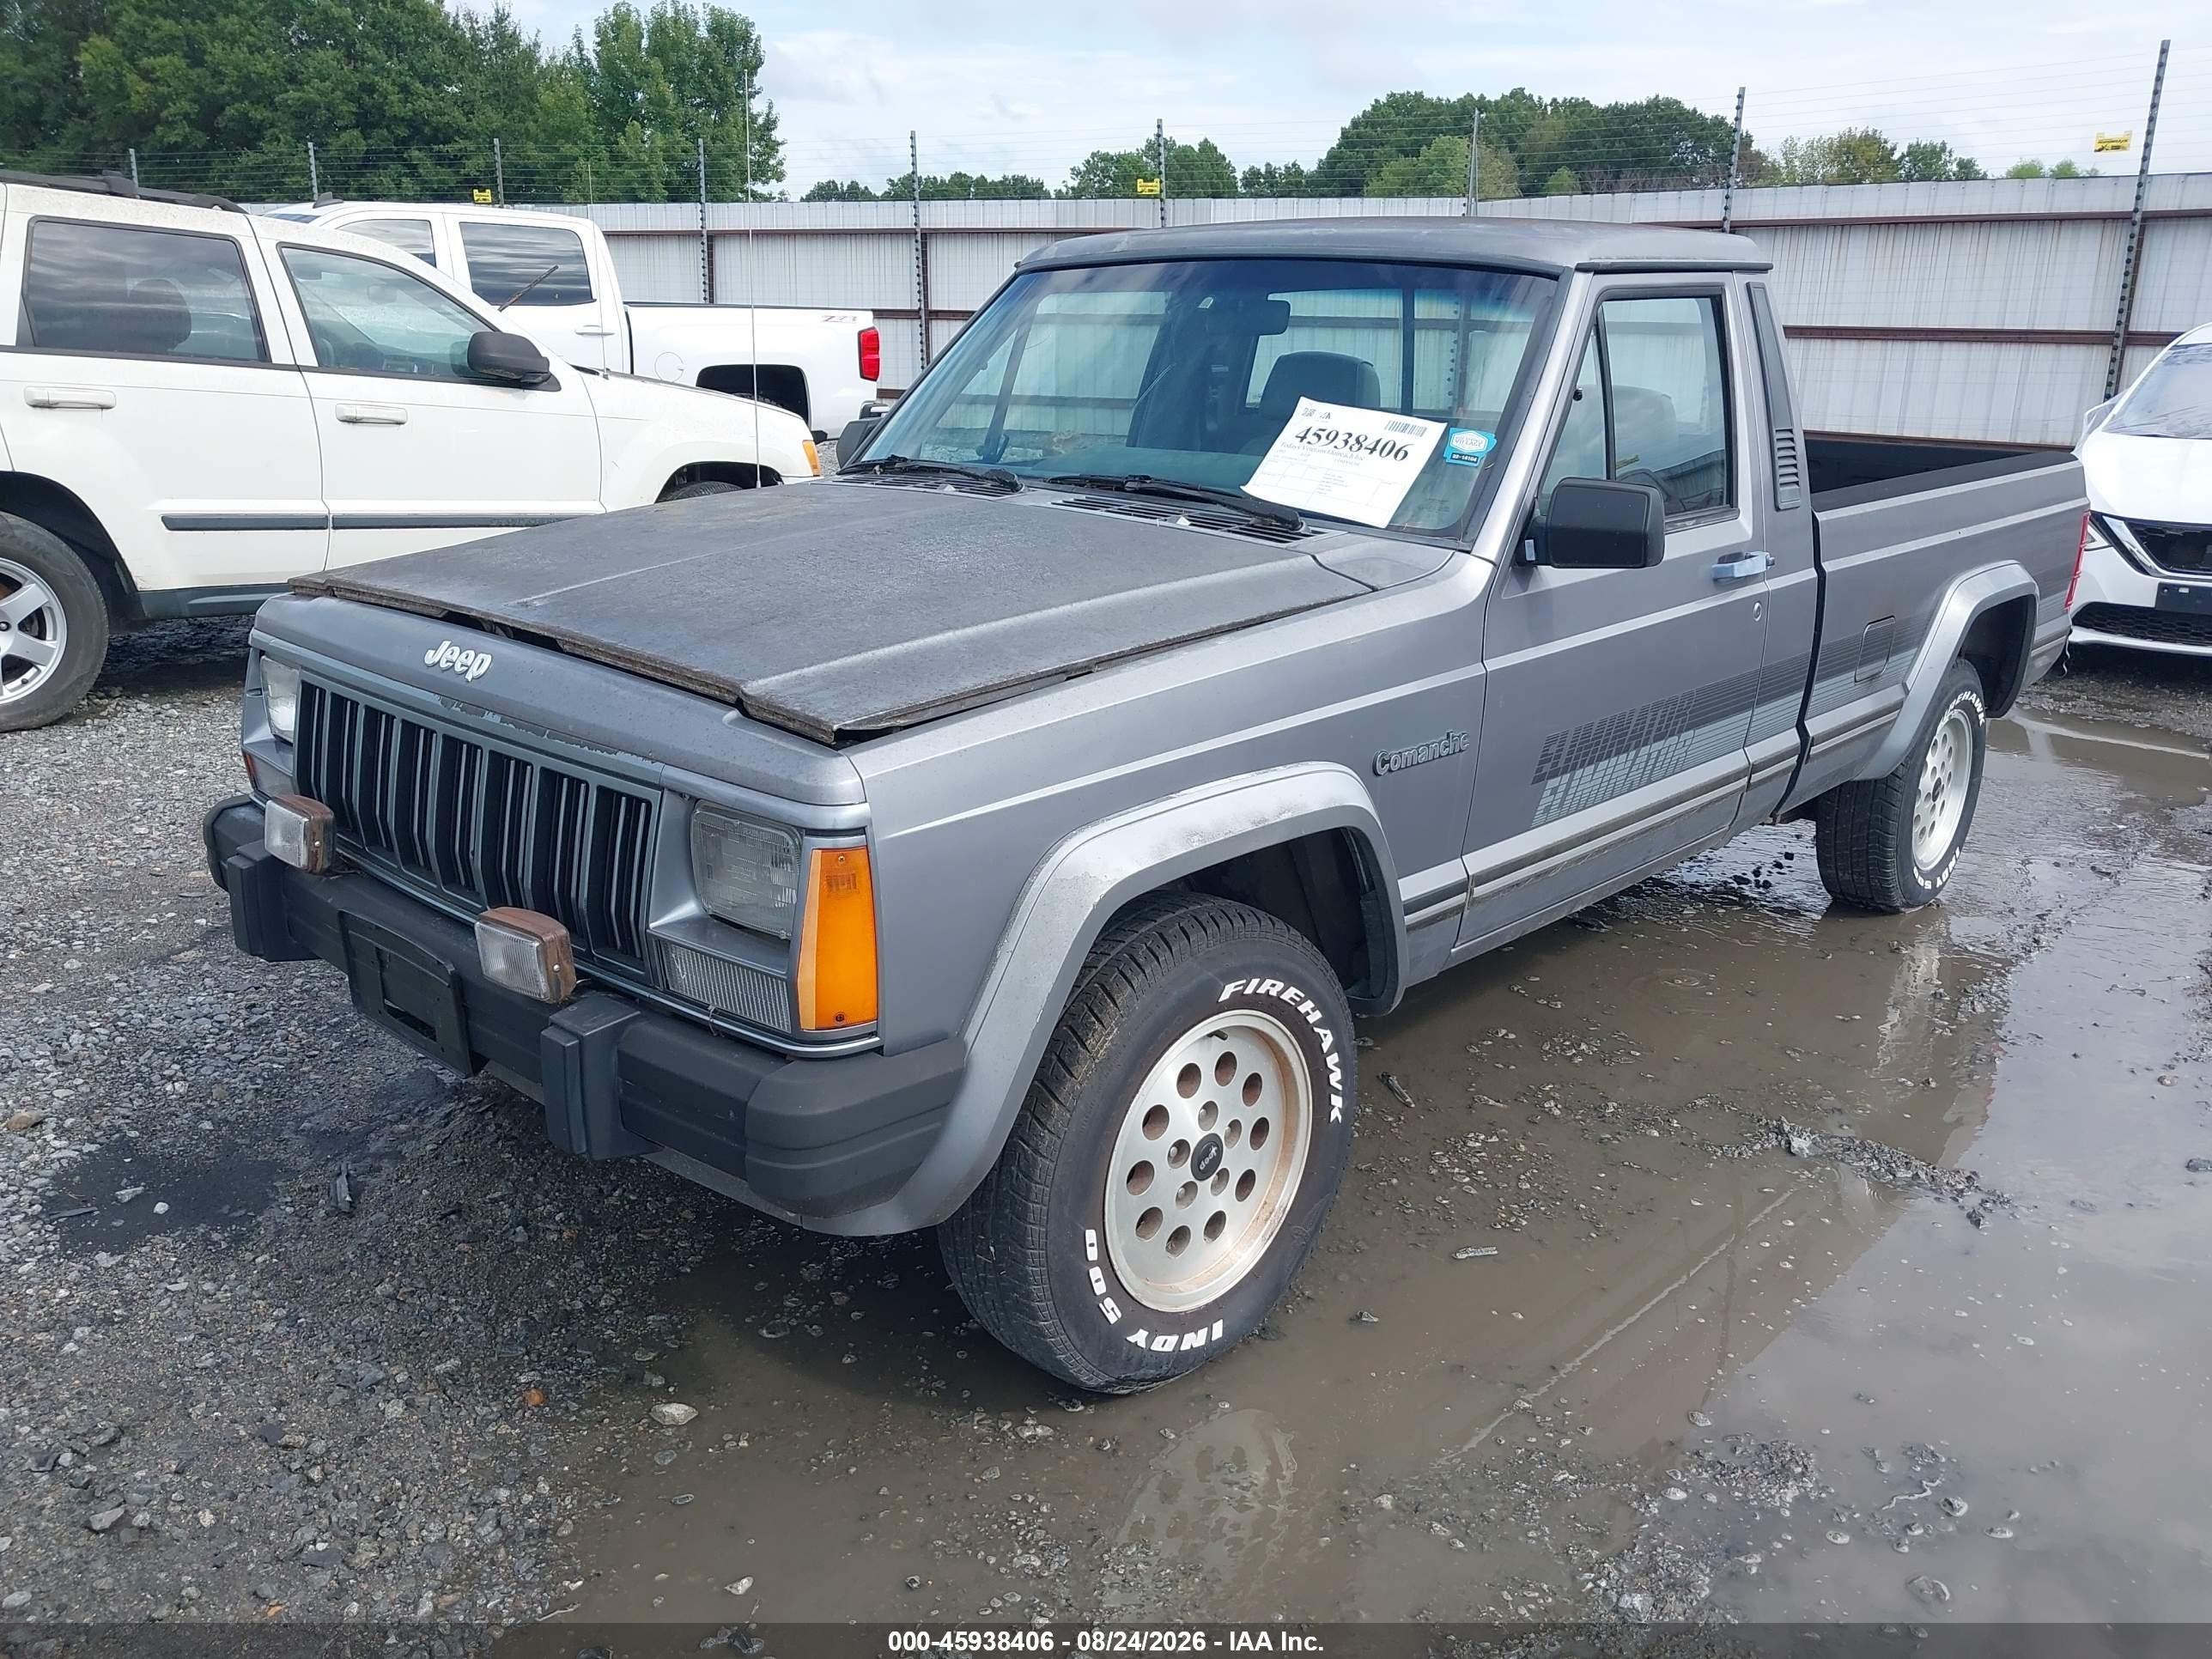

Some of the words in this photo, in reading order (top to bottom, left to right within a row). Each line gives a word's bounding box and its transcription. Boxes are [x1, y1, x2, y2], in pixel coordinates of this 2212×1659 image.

[1295, 426, 1415, 461] 45938406
[424, 640, 492, 682] Jeep
[1372, 730, 1469, 776] Comanche
[1913, 866, 1932, 890] 500
[1218, 978, 1343, 1123] FIREHAWK
[1085, 1229, 1122, 1325] 500
[1126, 1319, 1224, 1352] INDY
